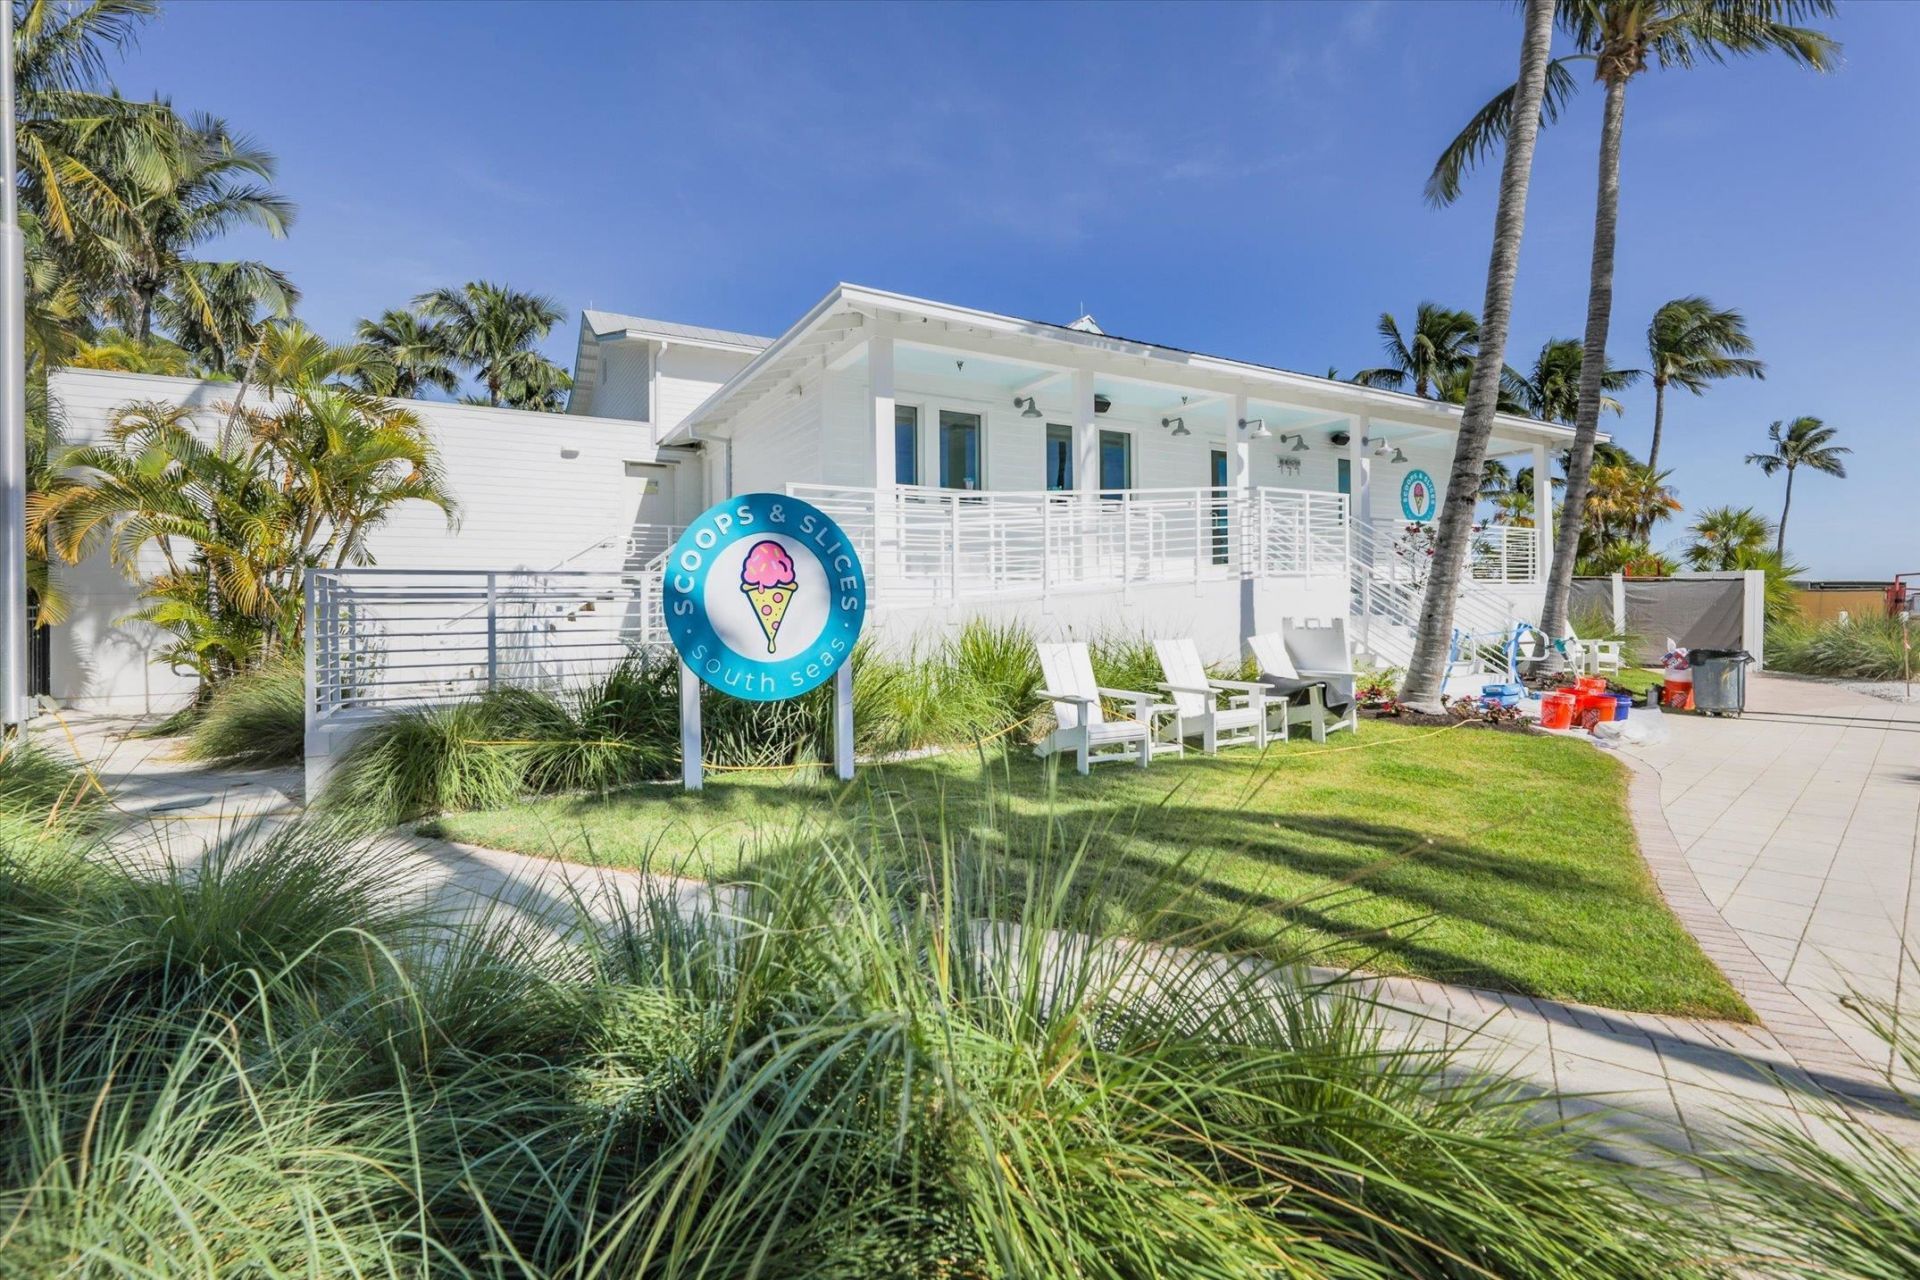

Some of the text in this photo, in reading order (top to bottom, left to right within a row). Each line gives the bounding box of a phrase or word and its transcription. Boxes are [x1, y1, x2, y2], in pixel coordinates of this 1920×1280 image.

[674, 504, 858, 615] SCOOPS & SLICES
[692, 637, 845, 693] south seas
